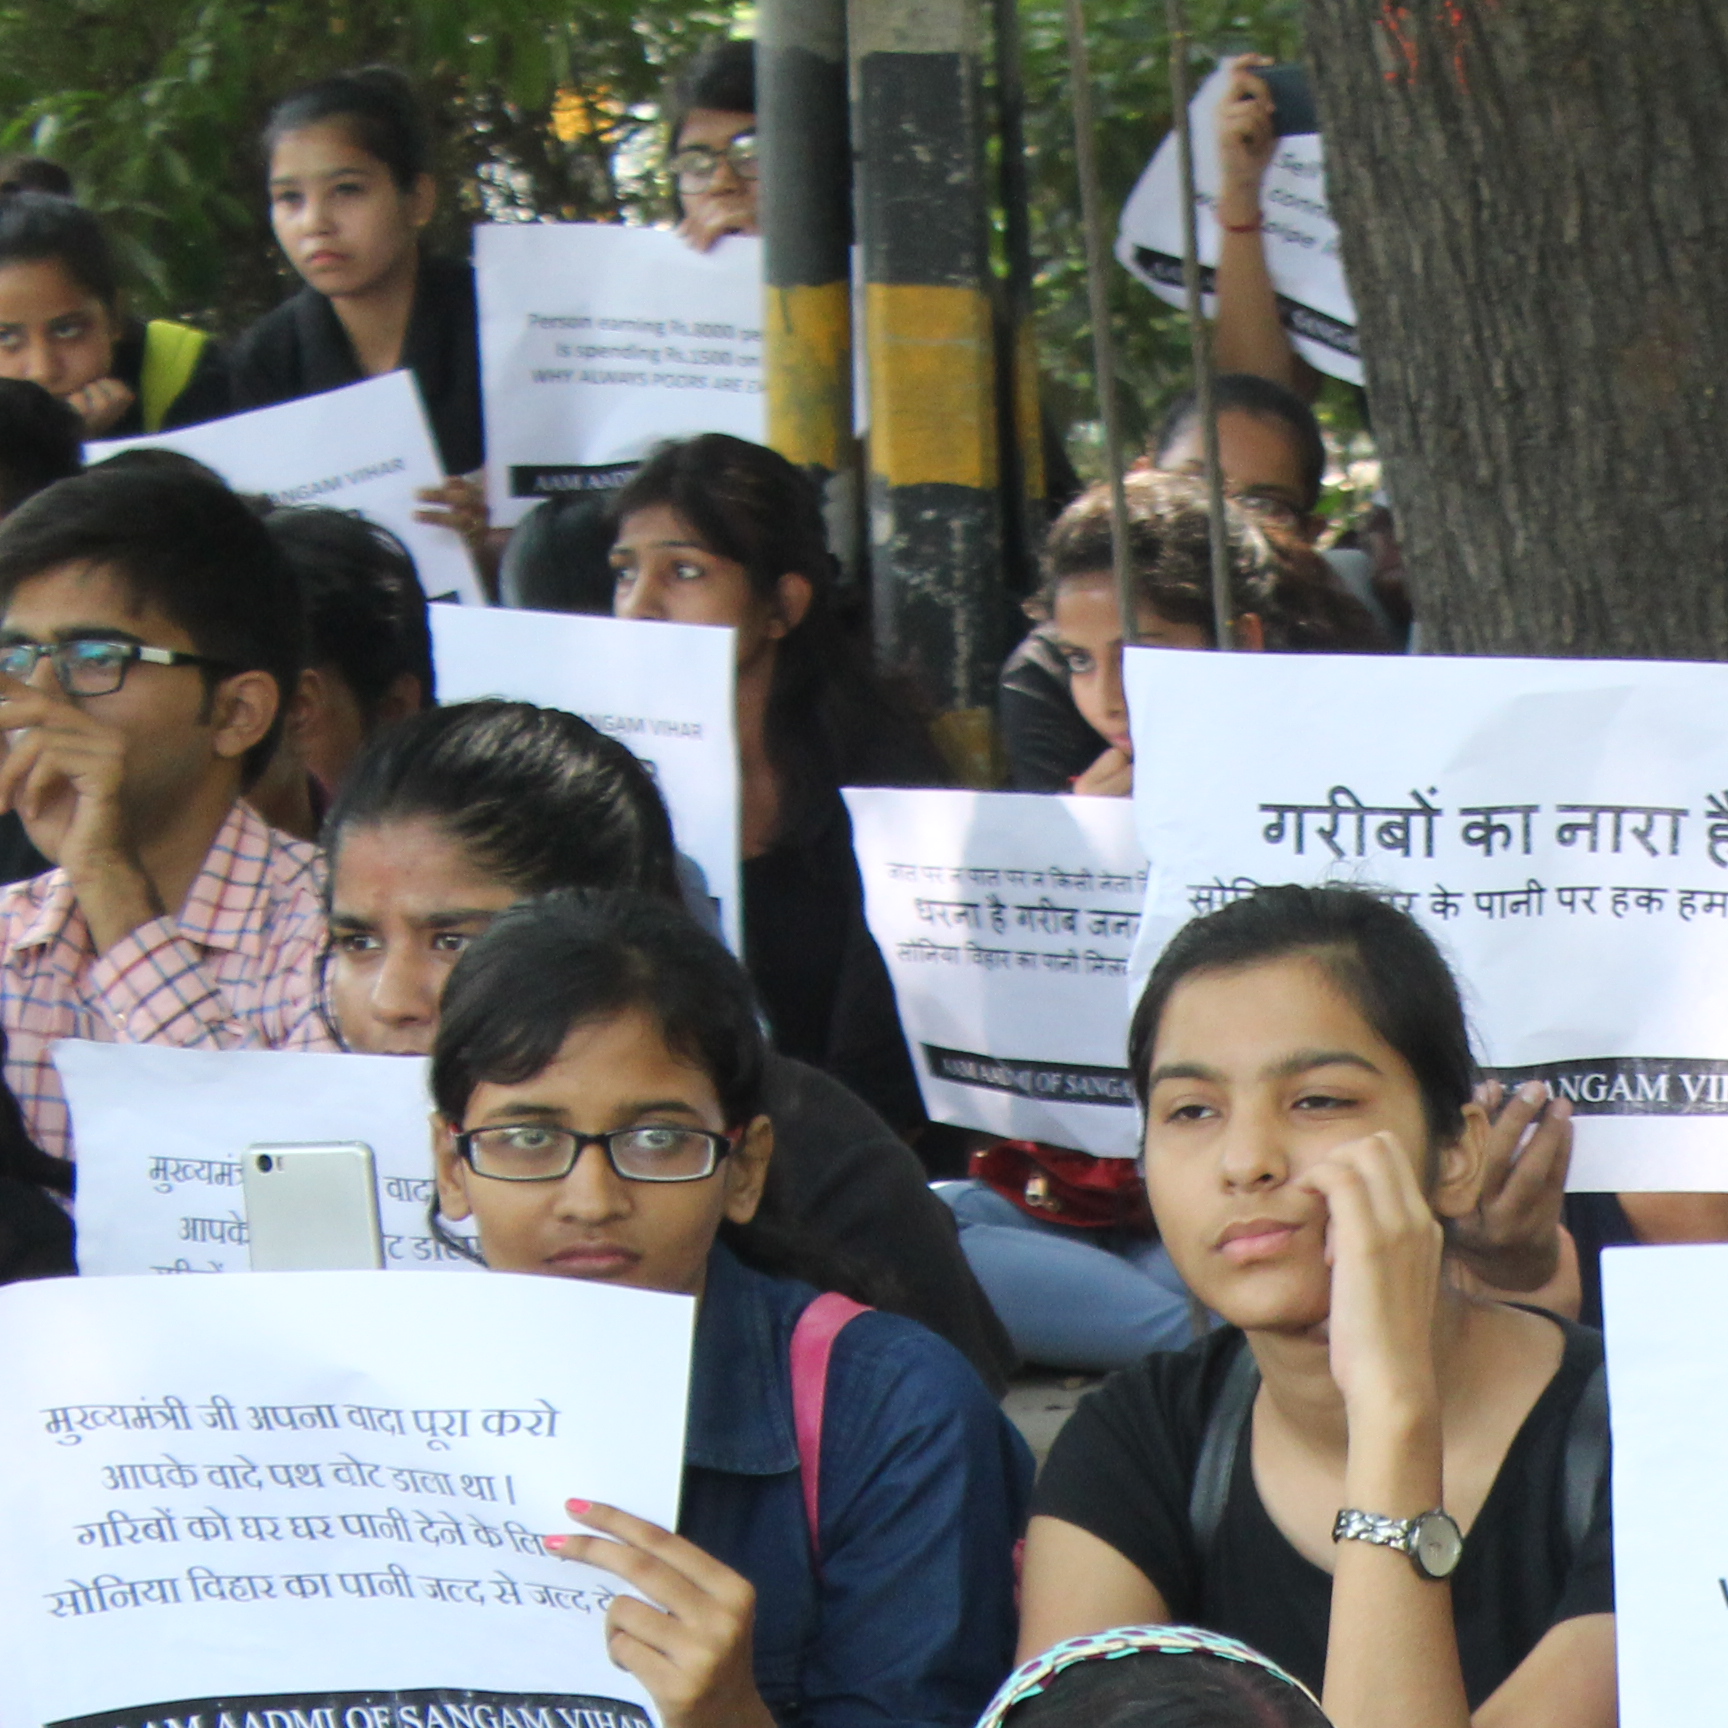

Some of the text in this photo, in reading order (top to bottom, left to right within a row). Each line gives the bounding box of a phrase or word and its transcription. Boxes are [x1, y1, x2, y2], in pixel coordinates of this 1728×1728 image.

[1259, 785, 1443, 859] गरीबों
[1459, 804, 1539, 858] का
[1556, 803, 1690, 857] नारा
[914, 892, 1080, 936] धरना है गरीब
[1430, 884, 1462, 921] के
[1473, 880, 1546, 920] पानी
[1557, 886, 1599, 918] पर
[1610, 886, 1665, 920] हक
[1545, 1073, 1668, 1104] ANGAM
[40, 1394, 562, 1451] मुख्यमंत्री जी अपना वादा पूरा करो
[101, 1451, 499, 1502] आपके वादे पथ वोट डाला था
[72, 1505, 504, 1549] गरिबों को घर घर पानी देने के
[42, 1562, 592, 1619] सोनिया विहार का पानी जल्द से जल्द
